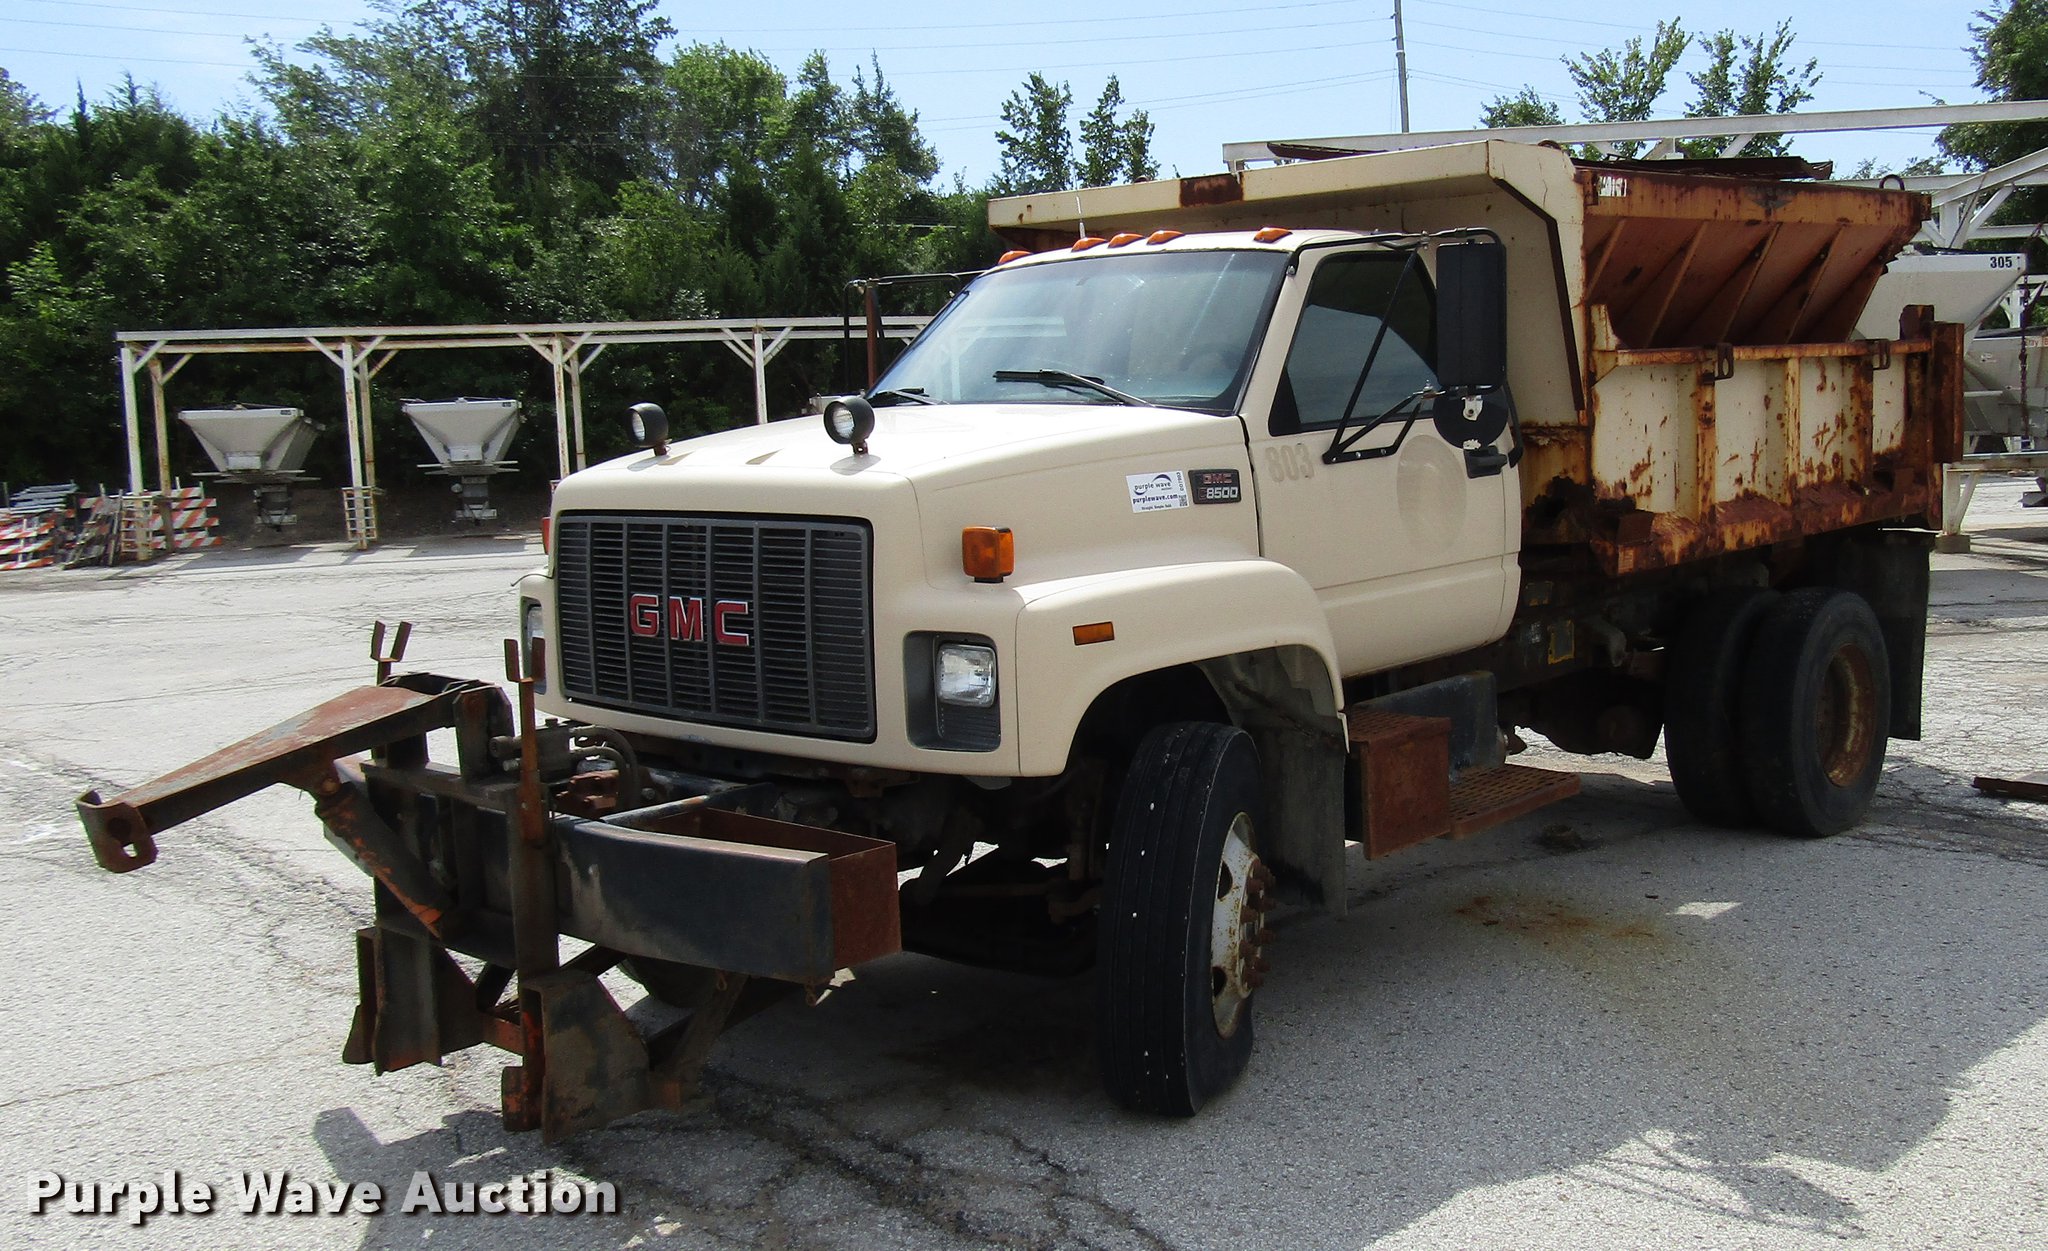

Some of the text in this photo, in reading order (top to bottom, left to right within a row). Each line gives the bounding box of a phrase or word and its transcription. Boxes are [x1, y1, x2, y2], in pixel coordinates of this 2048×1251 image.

[1989, 256, 2013, 269] 305
[1265, 443, 1315, 482] 803
[1202, 473, 1232, 484] GMC
[1134, 482, 1154, 491] purple
[1132, 493, 1178, 504] purplewave.com
[630, 593, 750, 647] GMC
